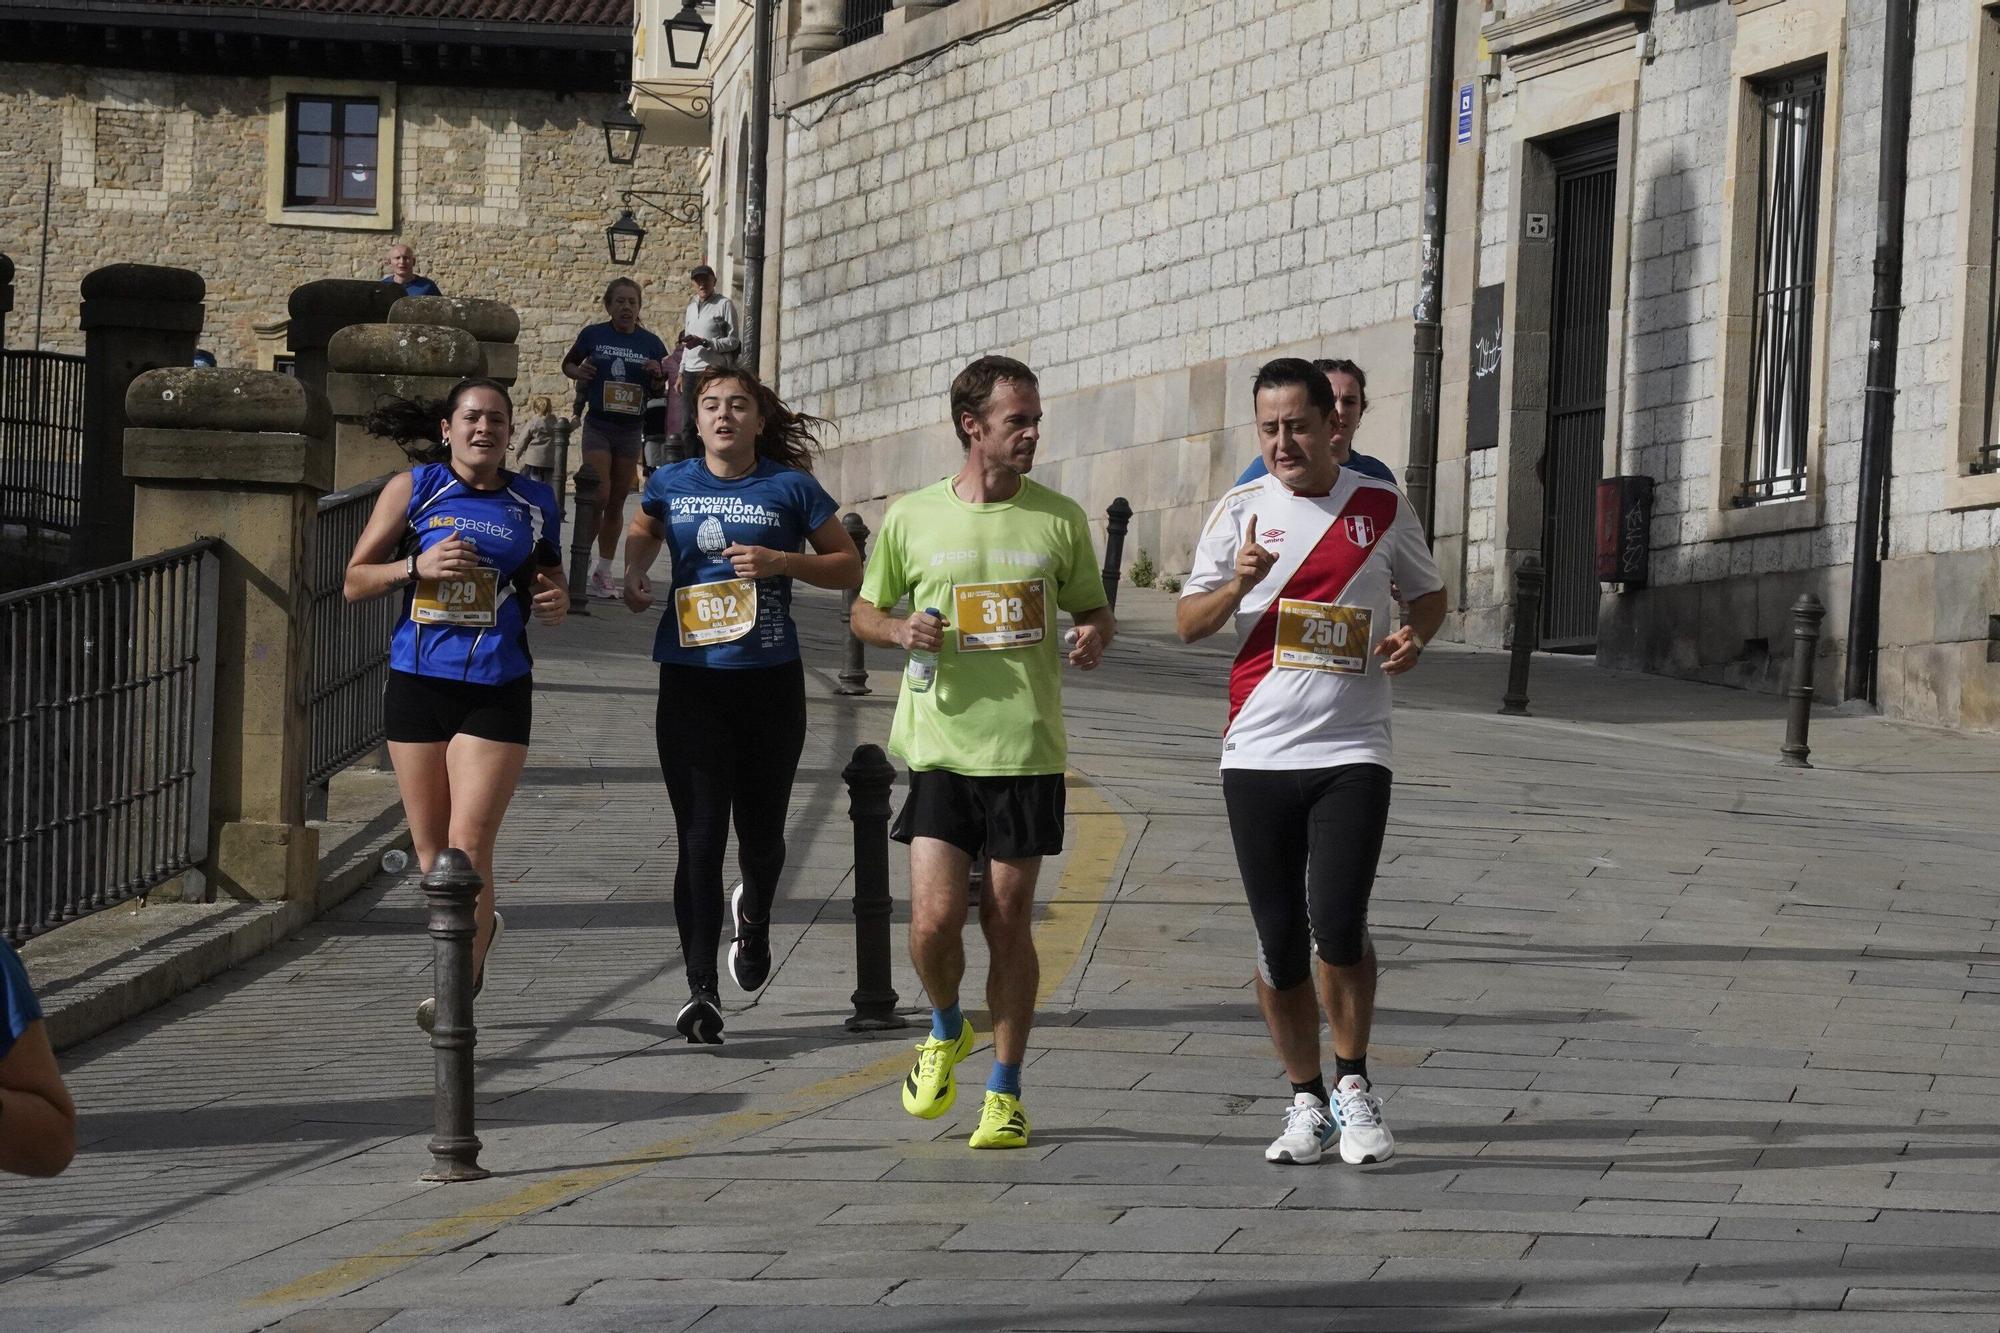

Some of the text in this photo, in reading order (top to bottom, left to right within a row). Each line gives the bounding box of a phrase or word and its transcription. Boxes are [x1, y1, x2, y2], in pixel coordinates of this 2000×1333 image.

[603, 350, 644, 359] ALMENDRA
[615, 390, 634, 403] 524
[680, 496, 742, 506] CONQUISTA
[680, 504, 765, 516] ALMENDRA
[724, 514, 781, 527] KONKISTA
[437, 581, 476, 604] 629
[697, 595, 738, 622] 692
[982, 597, 1024, 625] 313
[1301, 618, 1348, 648] 250
